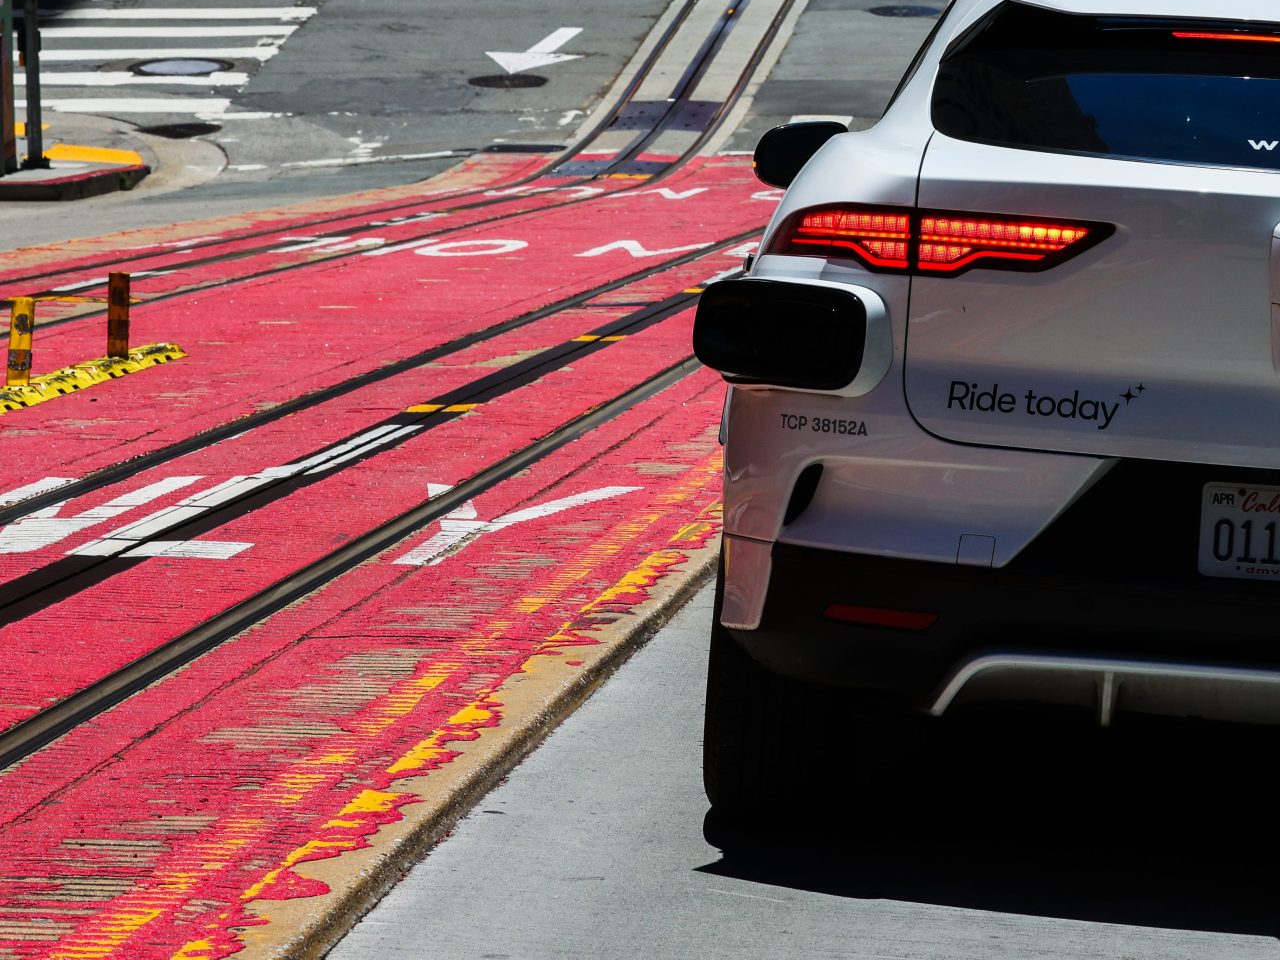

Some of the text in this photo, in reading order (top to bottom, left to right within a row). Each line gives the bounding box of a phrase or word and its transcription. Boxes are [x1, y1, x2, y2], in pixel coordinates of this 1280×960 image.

[947, 380, 1120, 430] Ride today
[781, 413, 868, 436] TCP 38152A
[1211, 493, 1235, 506] APR
[0, 476, 643, 566] NLY
